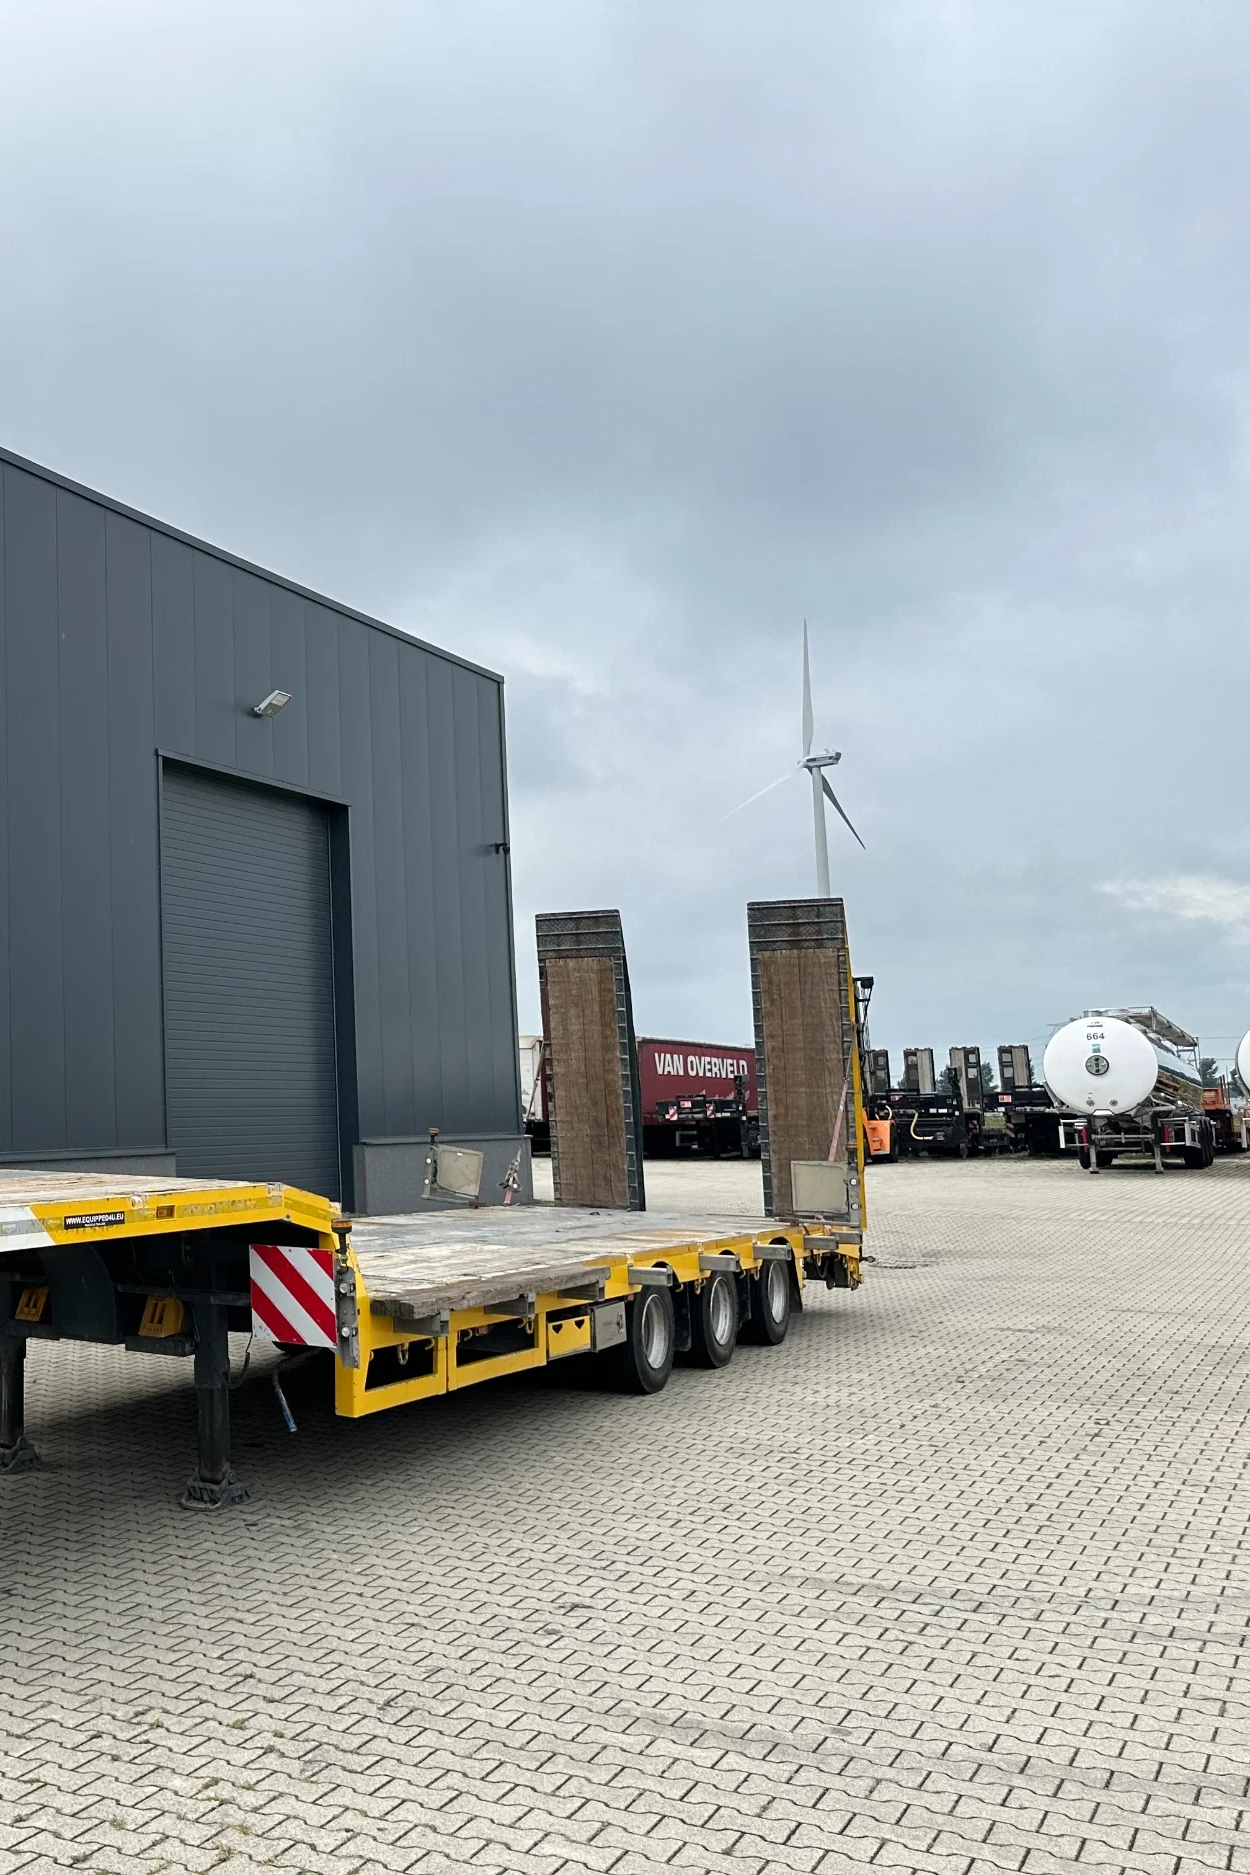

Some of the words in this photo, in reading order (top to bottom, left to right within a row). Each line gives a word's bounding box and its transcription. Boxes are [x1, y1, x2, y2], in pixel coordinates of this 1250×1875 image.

[1086, 1032, 1105, 1041] 664
[654, 1052, 684, 1076] VAN
[687, 1055, 748, 1079] OVERVELD
